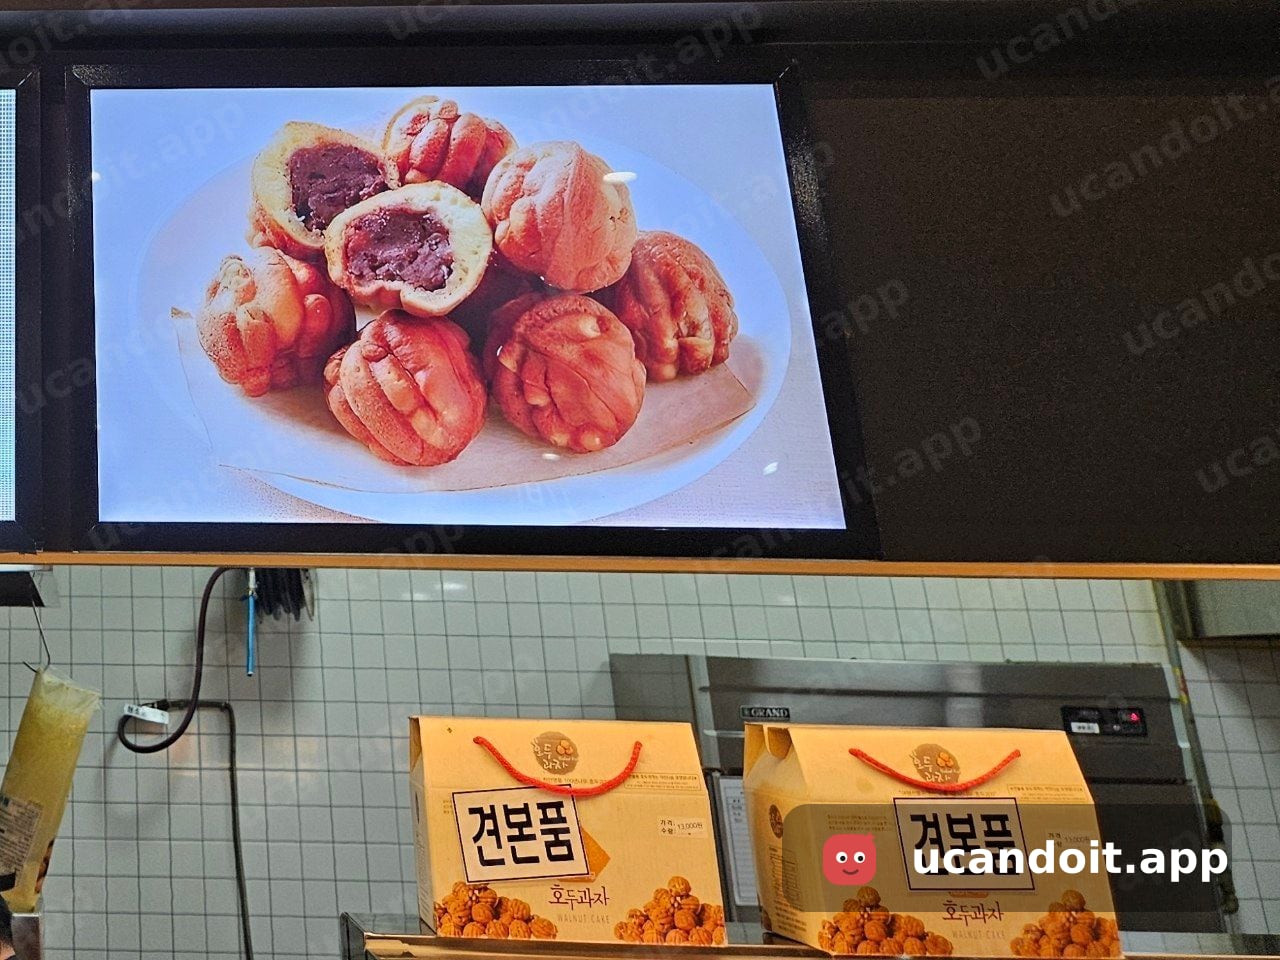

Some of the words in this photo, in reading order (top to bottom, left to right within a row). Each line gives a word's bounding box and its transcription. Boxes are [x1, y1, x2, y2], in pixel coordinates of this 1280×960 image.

[468, 799, 576, 867] 견본품
[548, 884, 610, 911] 호두과자
[942, 900, 1005, 927] 호두과자
